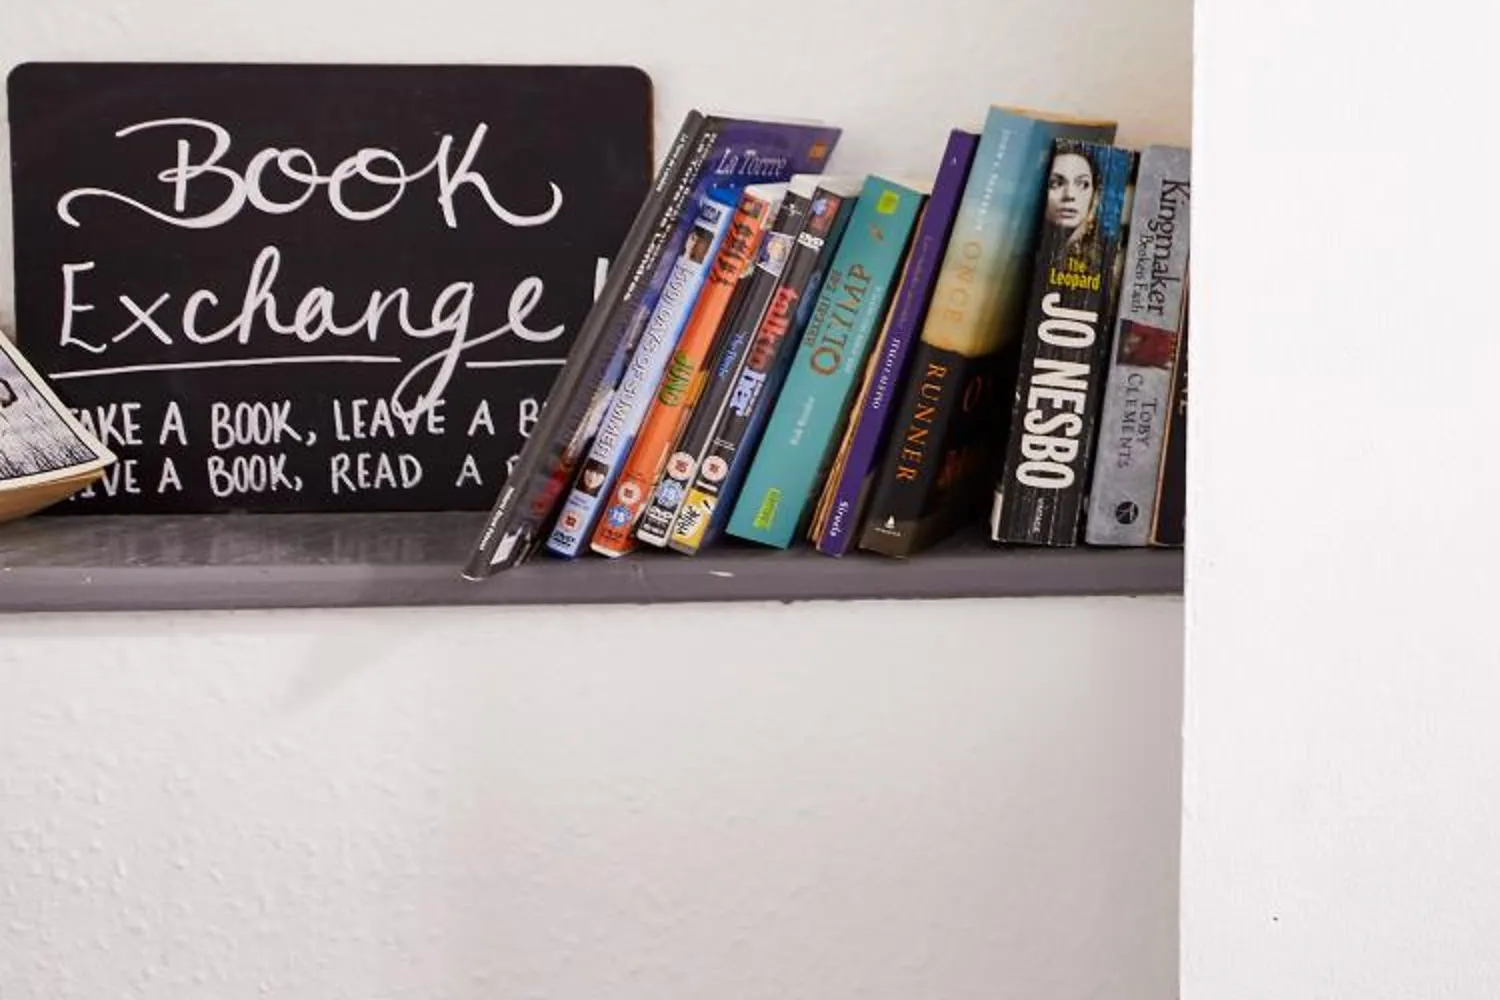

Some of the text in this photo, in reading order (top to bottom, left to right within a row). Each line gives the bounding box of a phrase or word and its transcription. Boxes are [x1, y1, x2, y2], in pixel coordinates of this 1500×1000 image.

[1068, 256, 1088, 272] The
[1146, 179, 1190, 317] Kingmaker
[1049, 266, 1102, 293] Leopard
[659, 353, 693, 407] JUNO
[1014, 292, 1100, 490] JO NESBO
[70, 403, 143, 446] AKE
[159, 401, 188, 446] A
[211, 400, 317, 450] BOOK,
[332, 398, 446, 442] LEAVE
[468, 400, 496, 437] A
[896, 361, 949, 482] RUNNER
[1117, 373, 1145, 470] CLEMENTS
[1136, 397, 1158, 447] TOBY
[157, 457, 183, 494] A
[207, 454, 305, 498] BOOK,
[330, 451, 424, 494] READ
[456, 455, 483, 488] A
